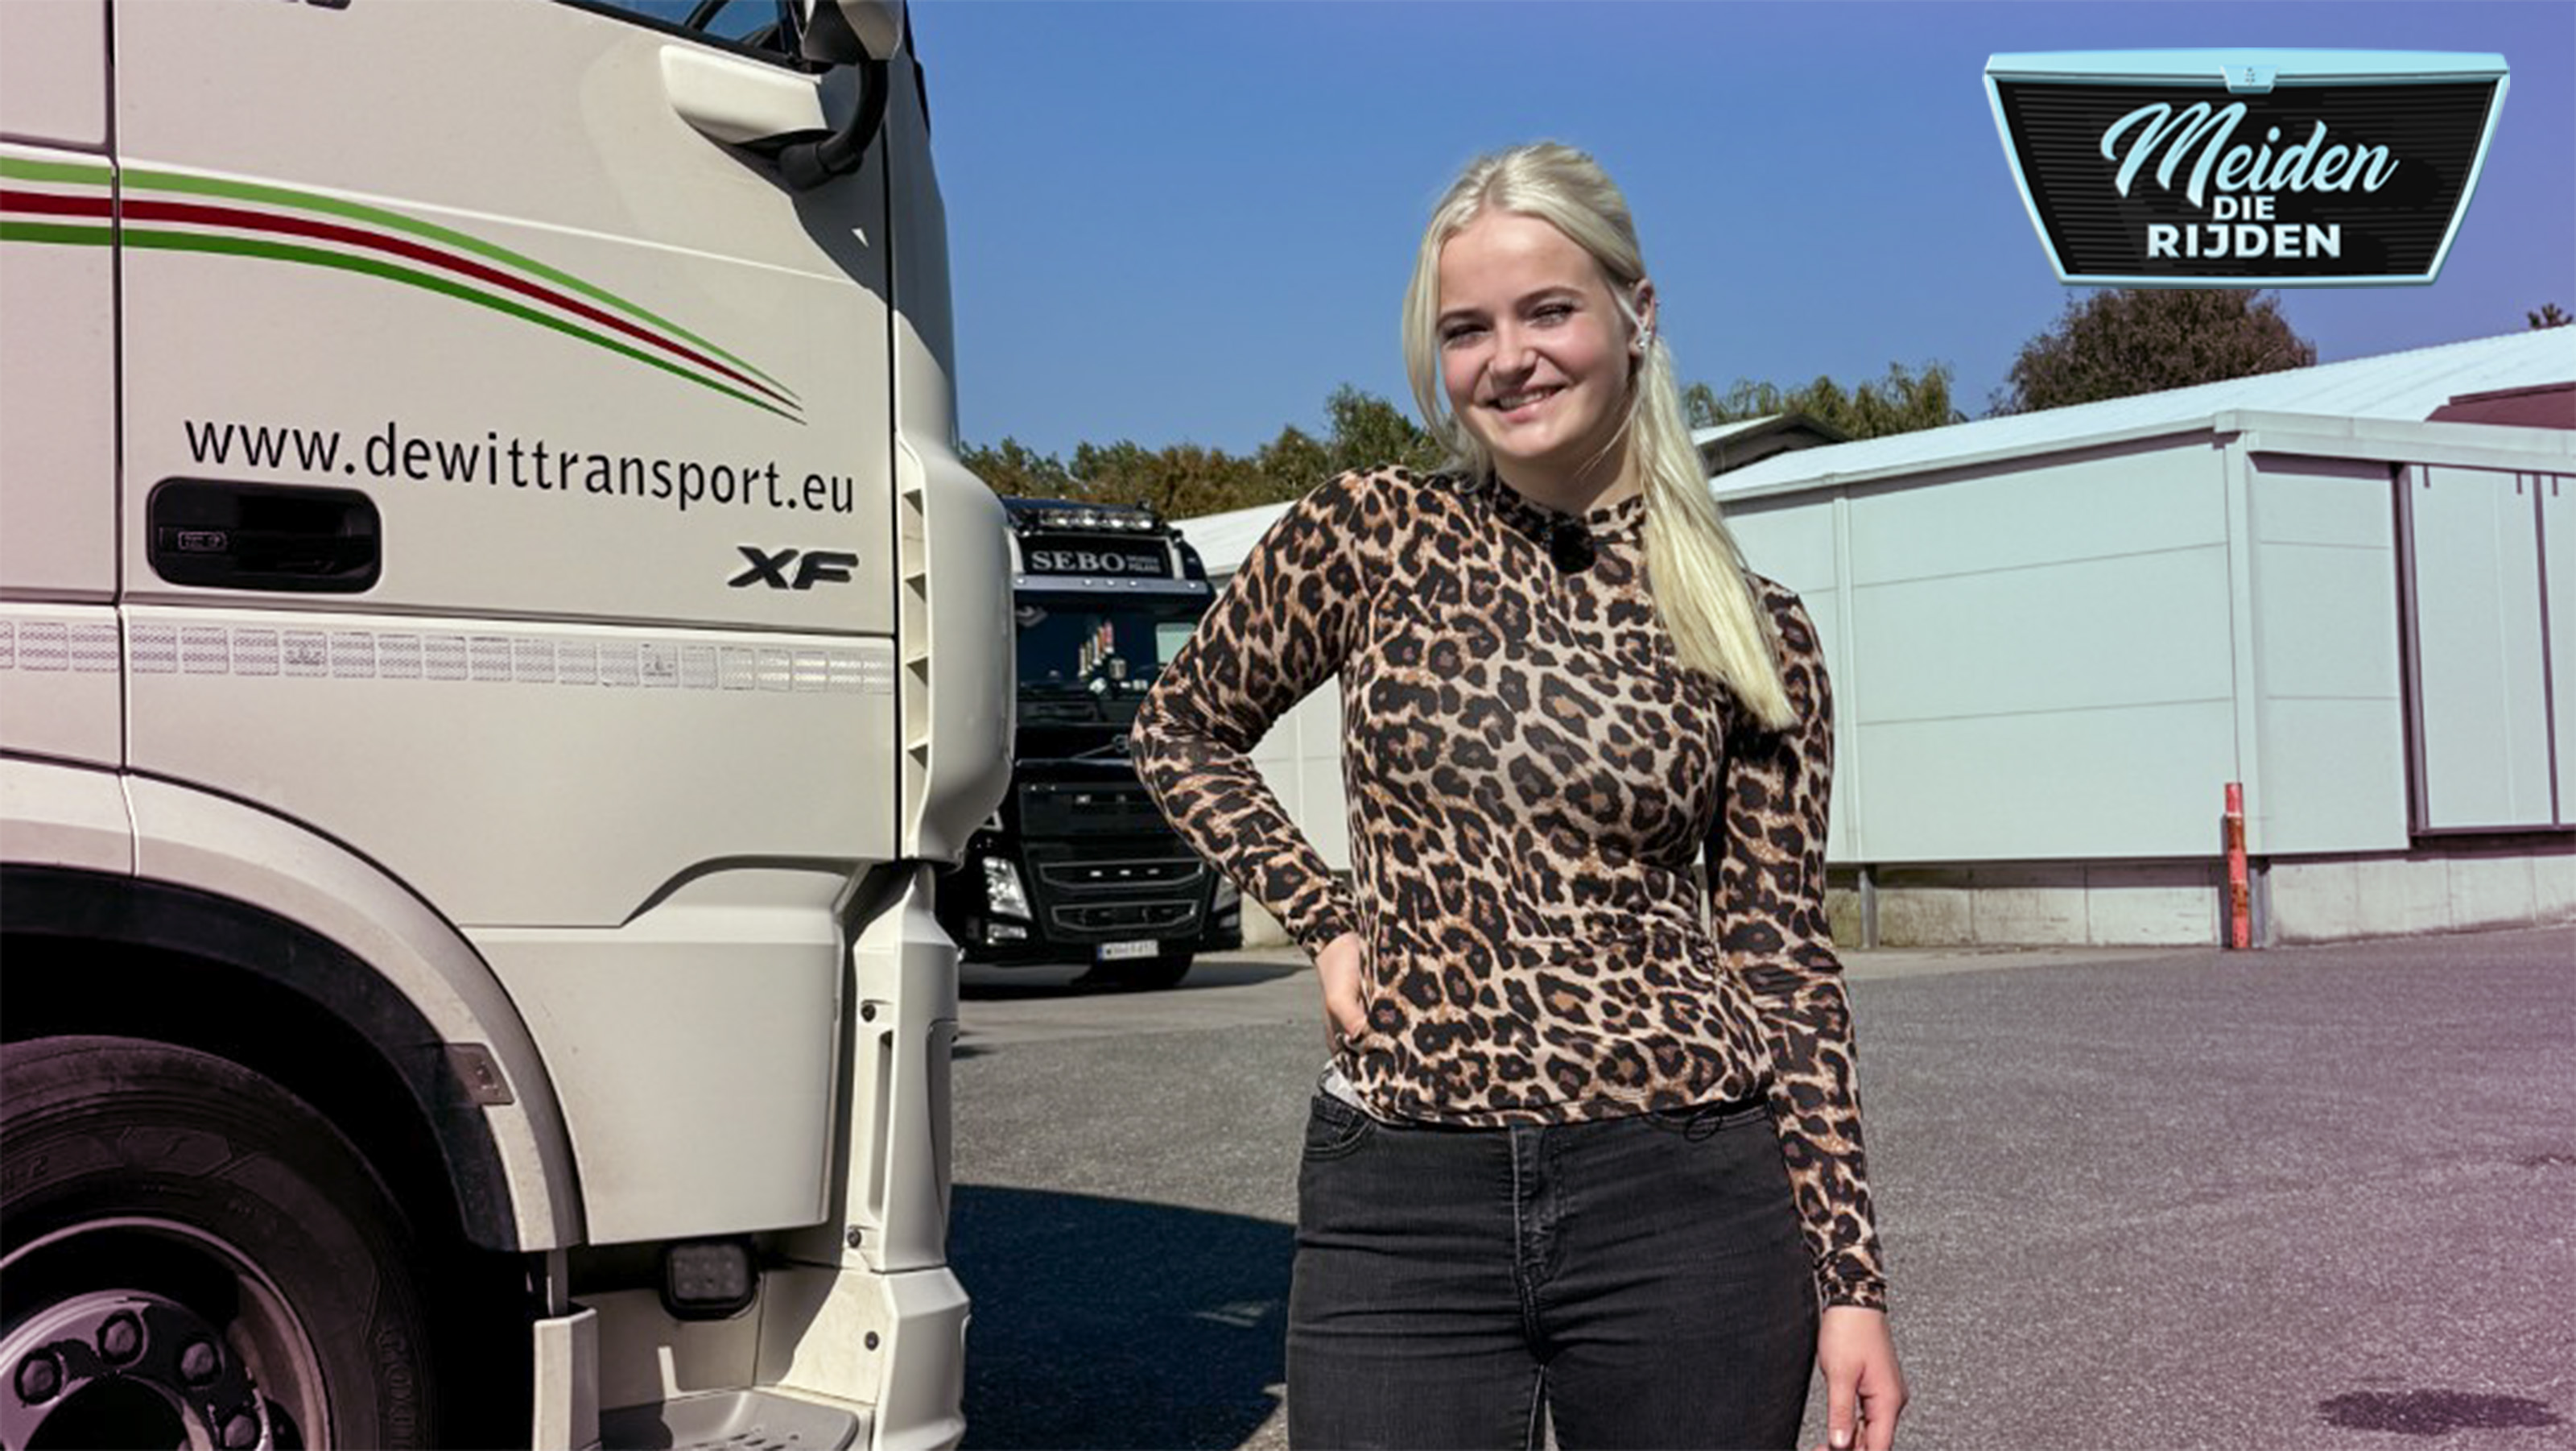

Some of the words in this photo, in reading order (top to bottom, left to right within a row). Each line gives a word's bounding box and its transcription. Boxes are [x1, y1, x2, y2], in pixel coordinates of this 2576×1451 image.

[184, 420, 853, 513] www.dewittransport.eu
[728, 546, 860, 590] XF
[1031, 551, 1126, 572] SEBO
